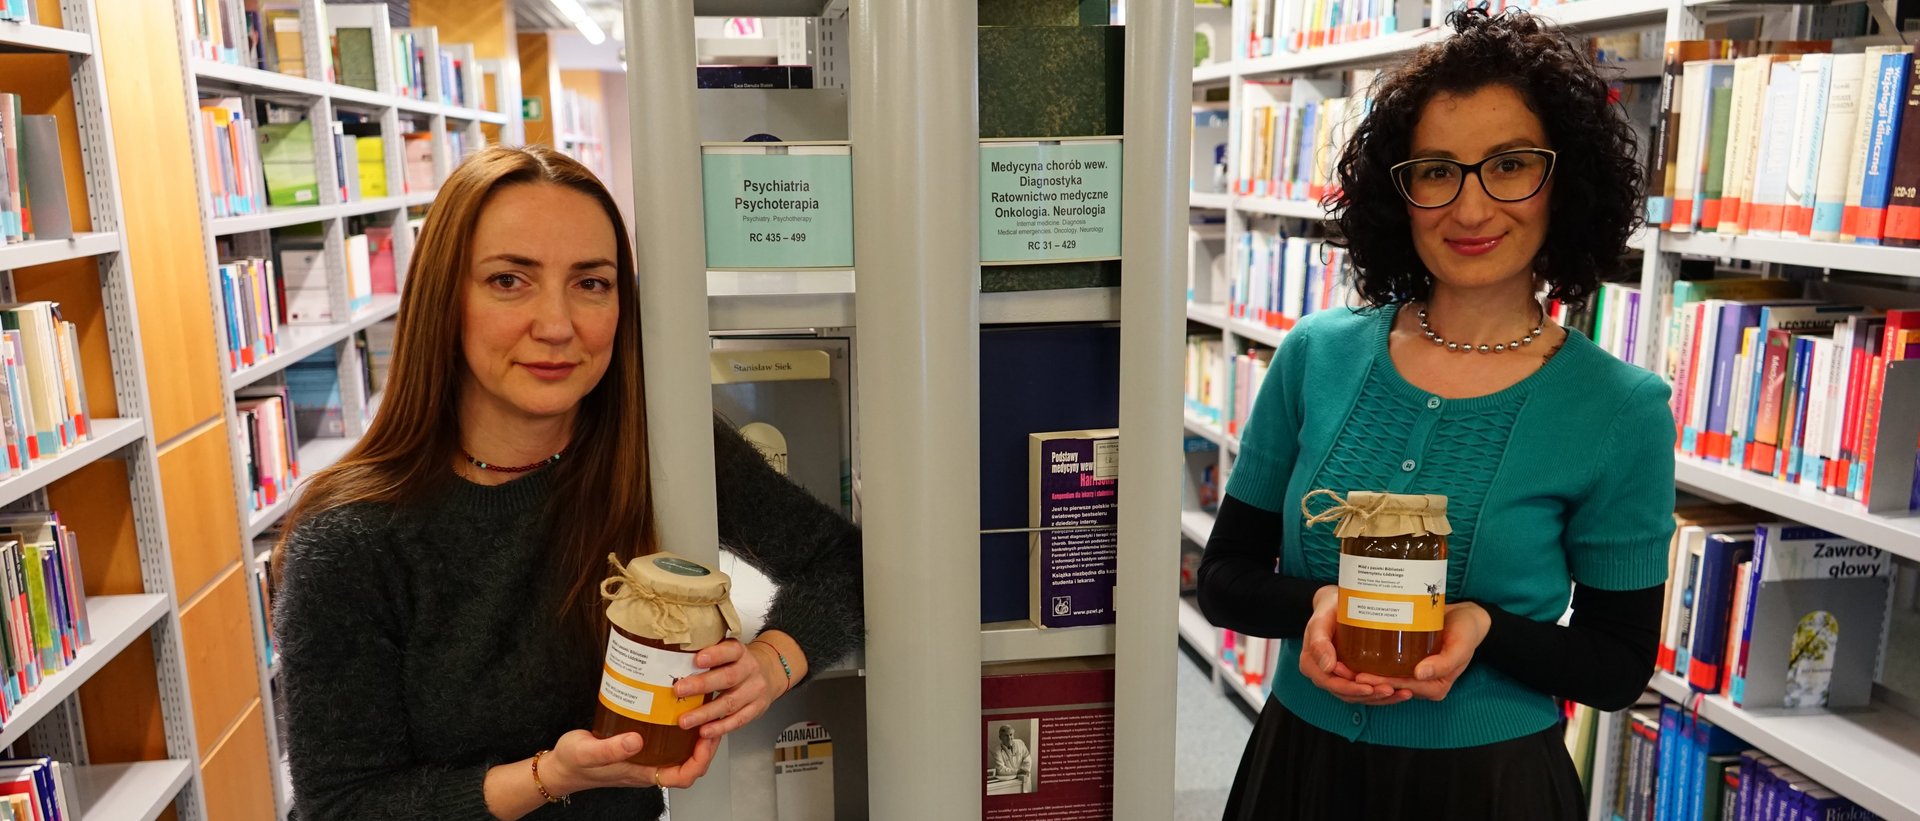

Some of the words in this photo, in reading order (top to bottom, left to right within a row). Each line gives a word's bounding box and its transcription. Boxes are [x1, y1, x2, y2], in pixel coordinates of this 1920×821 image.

[1878, 67, 1894, 118] fizjologii
[1868, 120, 1887, 176] klinicznej
[991, 162, 1044, 174] Medycyna
[1046, 160, 1082, 171] chorób
[1084, 160, 1108, 170] wew.
[744, 180, 810, 194] Psychiatria
[1020, 175, 1082, 188] Diagnostyka
[991, 192, 1058, 202] Ratownictwo
[1060, 190, 1108, 202] medyczne
[1894, 186, 1916, 199] ICD-10
[735, 198, 819, 212] Psychoterapia
[994, 206, 1050, 219] Onkologia.
[1053, 204, 1106, 217] Neurologia
[750, 233, 762, 242] RC
[766, 233, 781, 242] 435
[791, 233, 806, 242] 499
[1028, 241, 1040, 250] RC
[1043, 240, 1052, 250] 31
[1062, 240, 1076, 250] 429
[734, 363, 772, 372] Stanisław
[774, 362, 792, 371] Siek
[1052, 451, 1078, 463] Podstawy
[1052, 462, 1080, 474] medycyny
[1813, 543, 1882, 560] Zawroty
[1828, 560, 1880, 578] głowy
